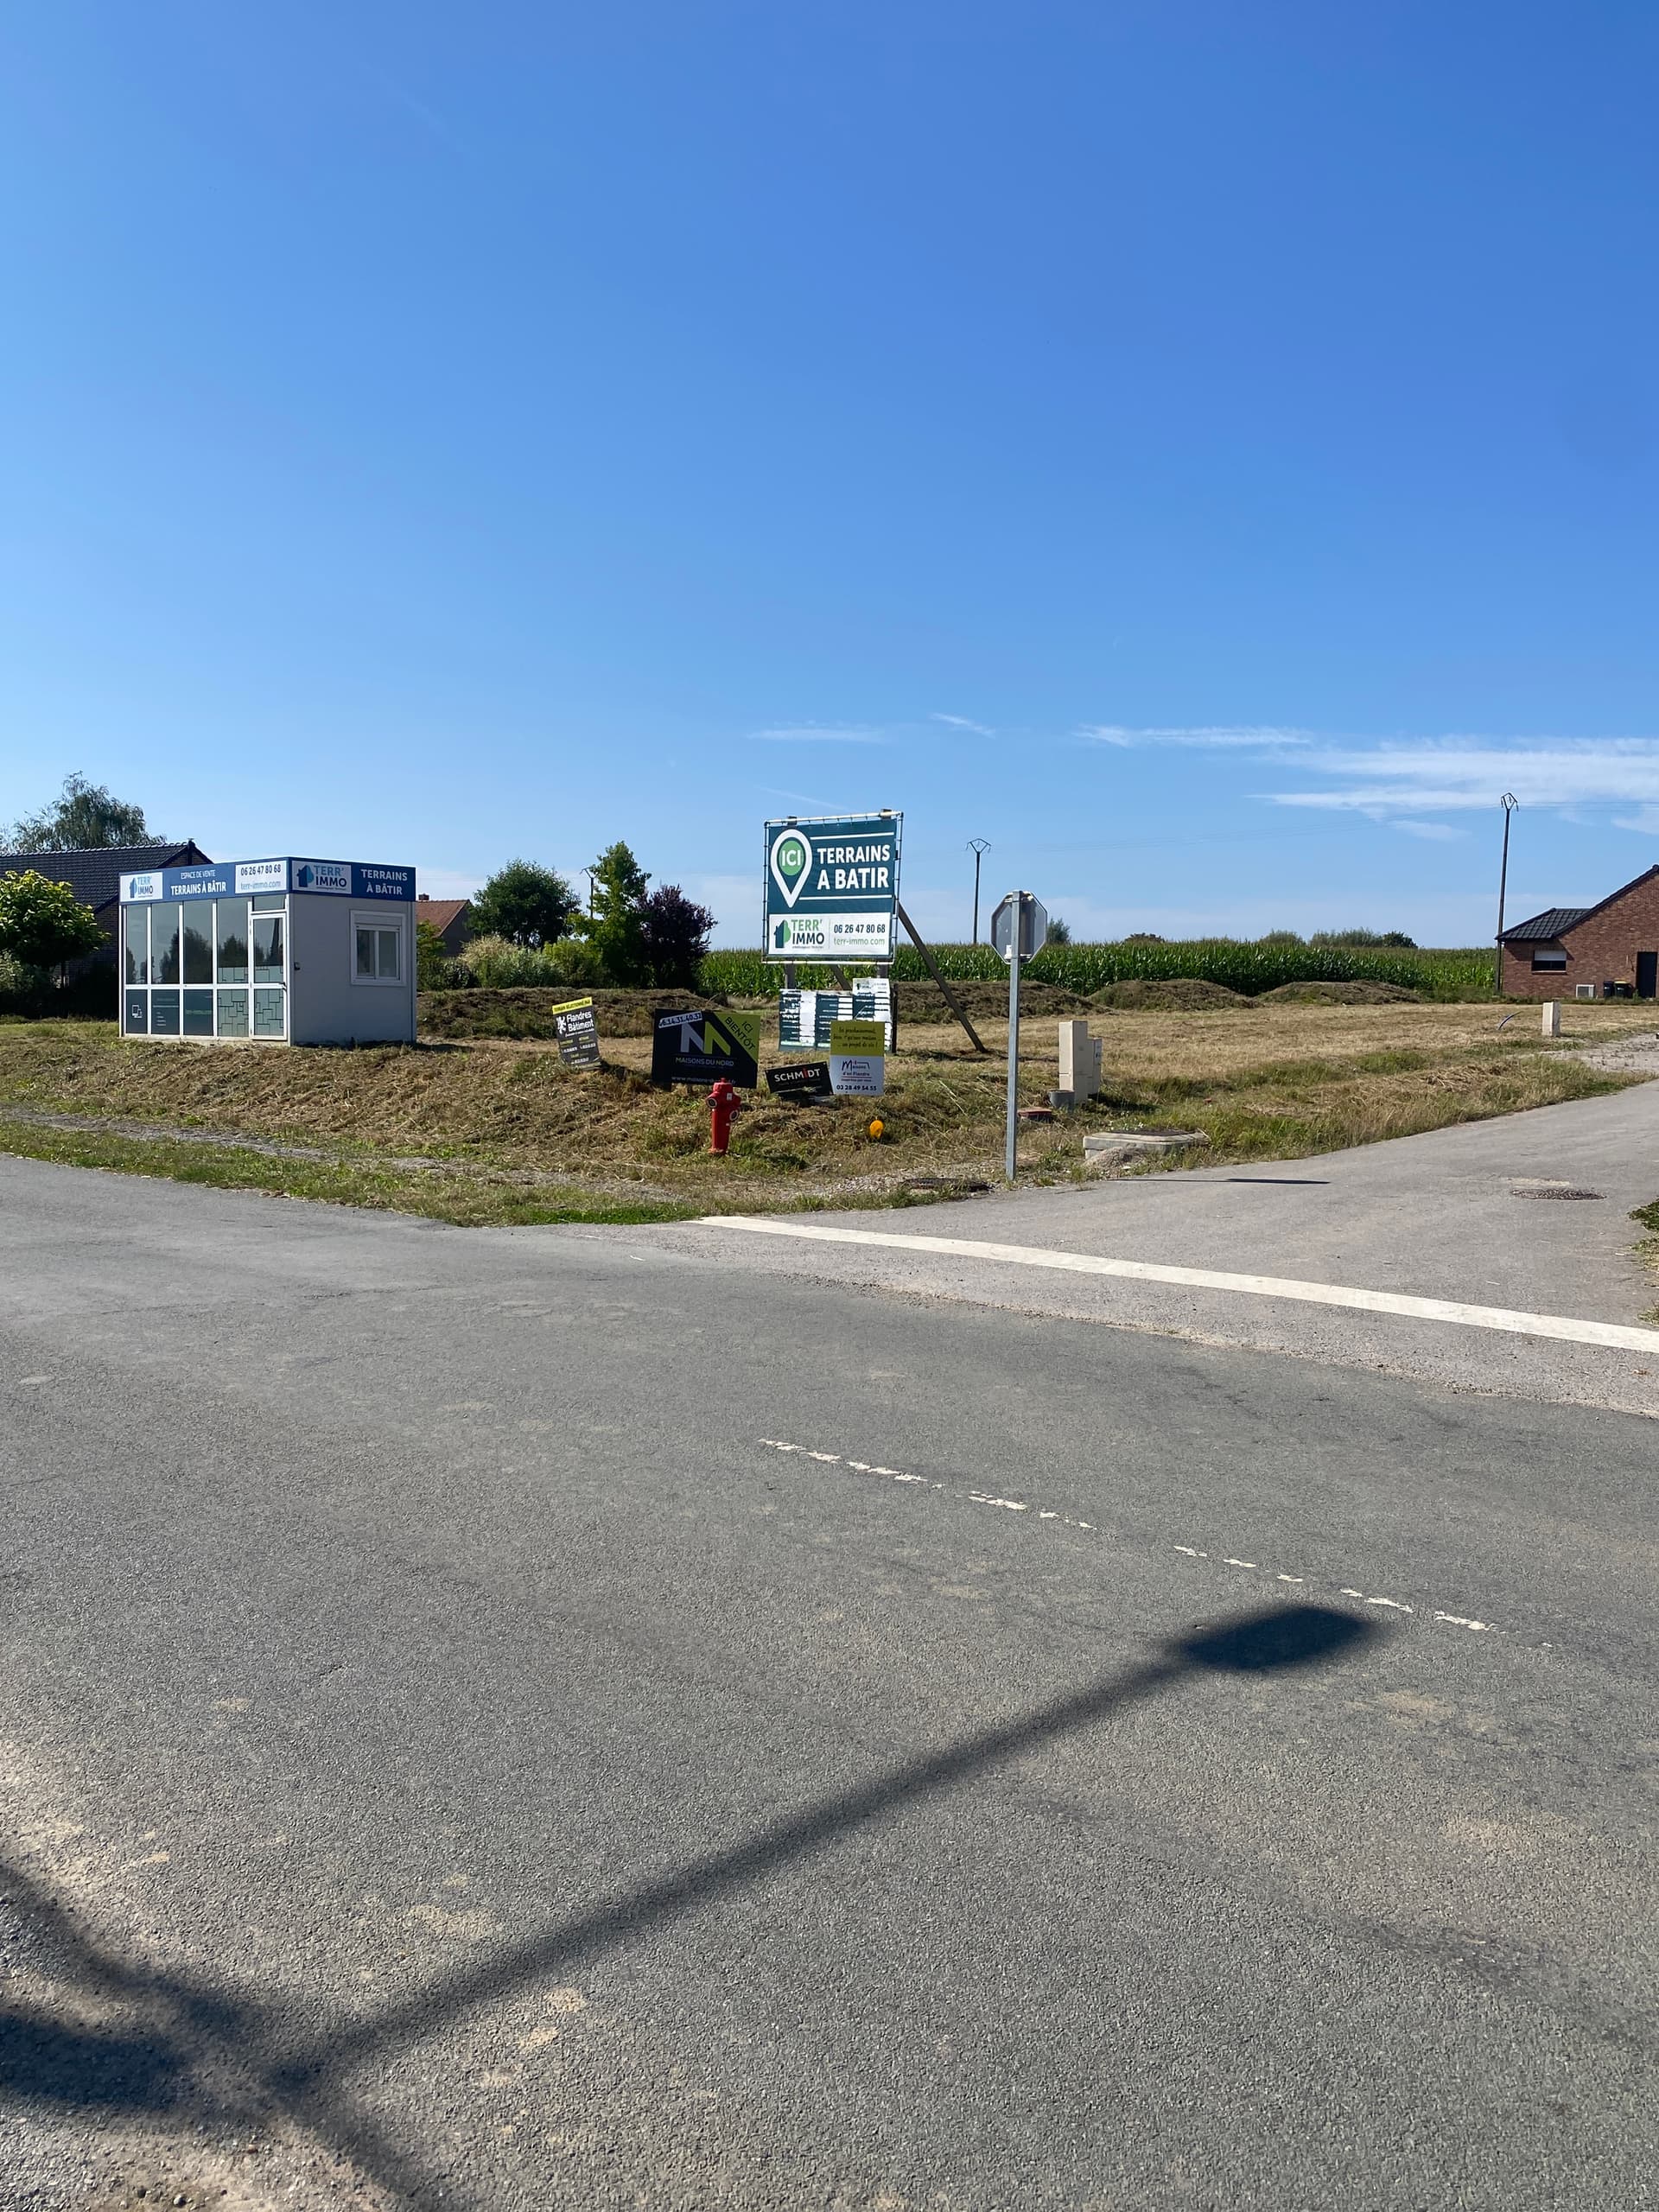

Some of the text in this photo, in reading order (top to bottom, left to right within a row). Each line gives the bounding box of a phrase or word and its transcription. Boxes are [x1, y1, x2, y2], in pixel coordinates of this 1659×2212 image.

[781, 849, 802, 867] ICI
[817, 844, 891, 864] TERRAINS
[181, 869, 215, 880] ESPACE DE VENTE
[240, 867, 248, 876] 06
[257, 865, 264, 874] 47
[264, 864, 273, 874] 80
[314, 865, 344, 876] TERR'
[361, 868, 408, 881] TERRAINS
[315, 875, 346, 887] IMMO
[817, 867, 889, 890] A BATIR
[138, 885, 154, 894] IMMO
[170, 879, 226, 895] TERRAINS À BÂTIR
[240, 880, 282, 890] terr-immo.com
[366, 881, 403, 895] À BÂTIR
[791, 918, 823, 931] TERR'
[834, 924, 886, 934] 06 26 47 80 68
[792, 932, 824, 944] IMMO
[834, 937, 886, 945] terr-immo.com
[566, 1011, 592, 1023] Flandres
[568, 1018, 594, 1032] Bâtiment
[741, 1021, 753, 1033] ICI
[725, 1016, 756, 1051] BIENTÔT
